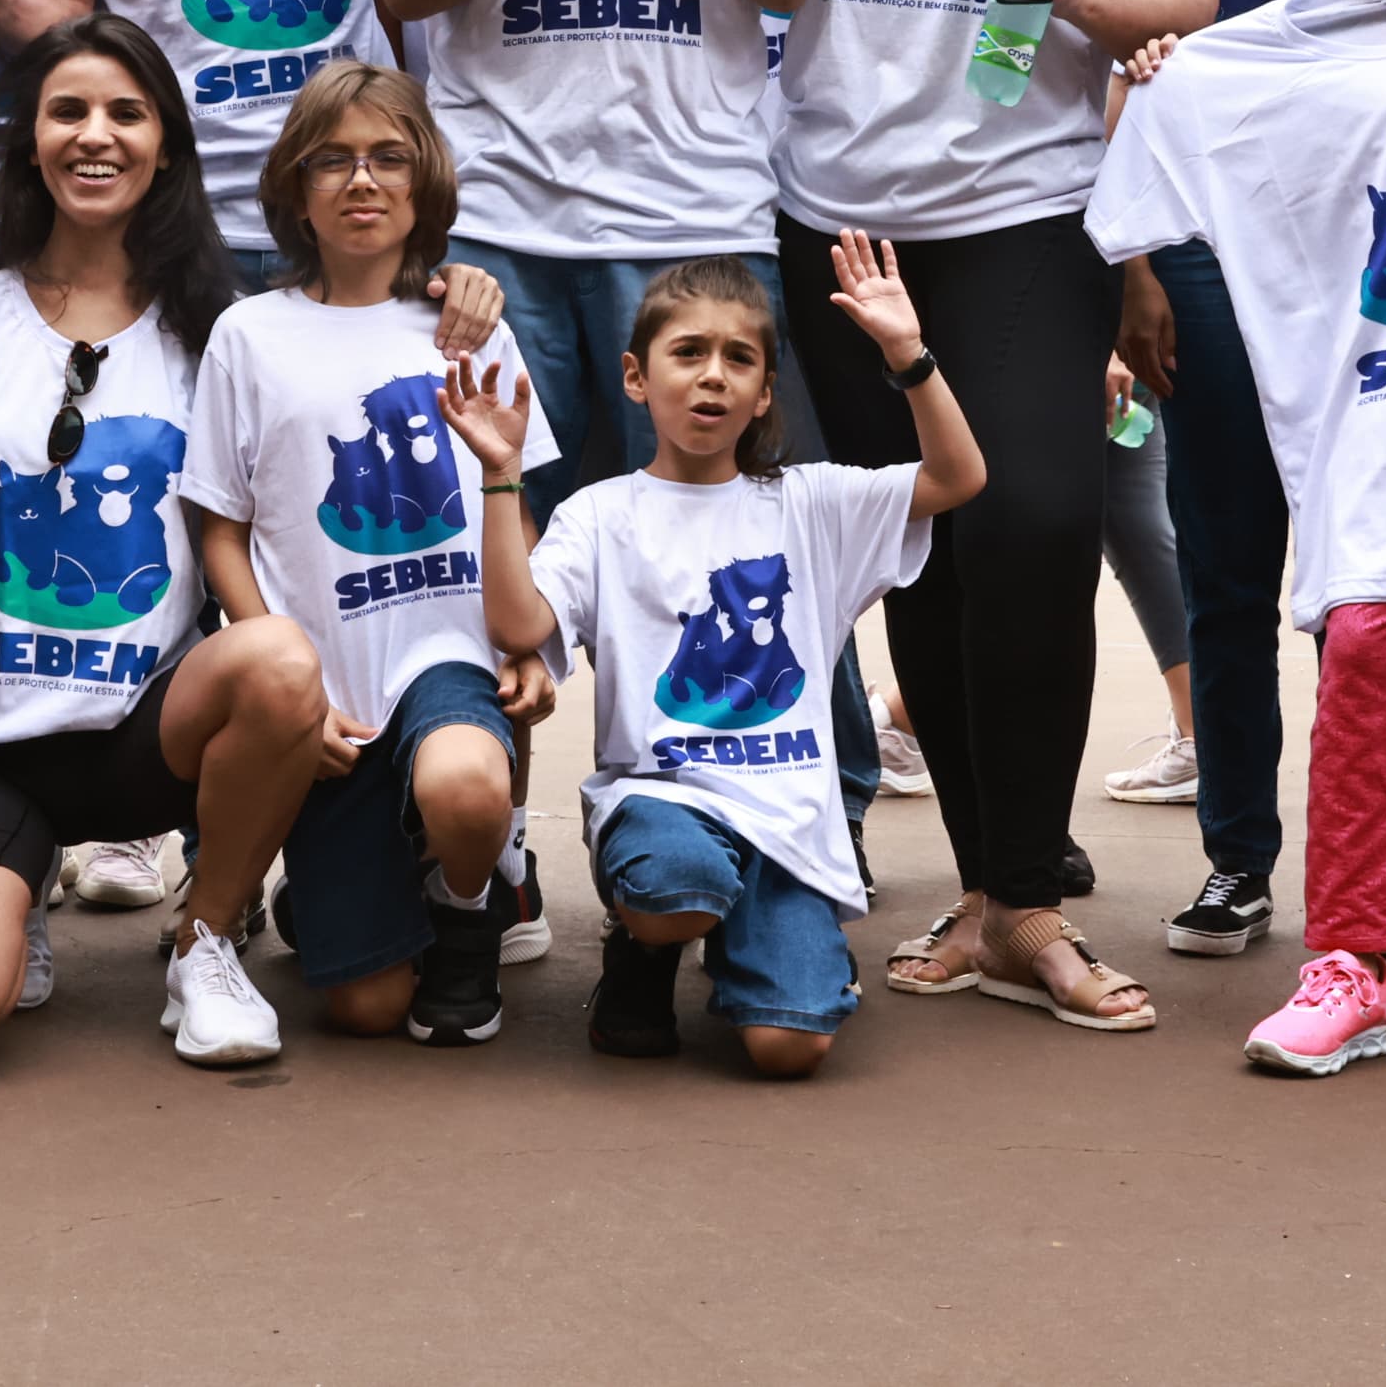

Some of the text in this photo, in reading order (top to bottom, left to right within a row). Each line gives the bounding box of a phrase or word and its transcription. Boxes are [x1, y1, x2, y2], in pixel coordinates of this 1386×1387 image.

[917, 0, 923, 9] E
[924, 1, 941, 10] BEM
[942, 4, 970, 14] ESTAR
[502, 31, 703, 48] SECRETARIA DE PROTEÇÃO E BEM ESTAR ANIMAL
[1007, 48, 1034, 63] crysta
[196, 94, 295, 117] SECRETARIA DE PROTE
[334, 550, 482, 610] SEBEM
[340, 605, 380, 622] SECRETARIA
[381, 601, 390, 611] DE
[390, 592, 426, 607] PROTEÇÃO
[426, 591, 432, 600] E
[433, 589, 448, 599] BEM
[4, 677, 17, 687] DE
[18, 677, 67, 692] PROTEÇÃO
[67, 683, 73, 692] E
[73, 684, 93, 695] BEM
[94, 686, 125, 697] ESTAR
[651, 728, 821, 770] SEBEM
